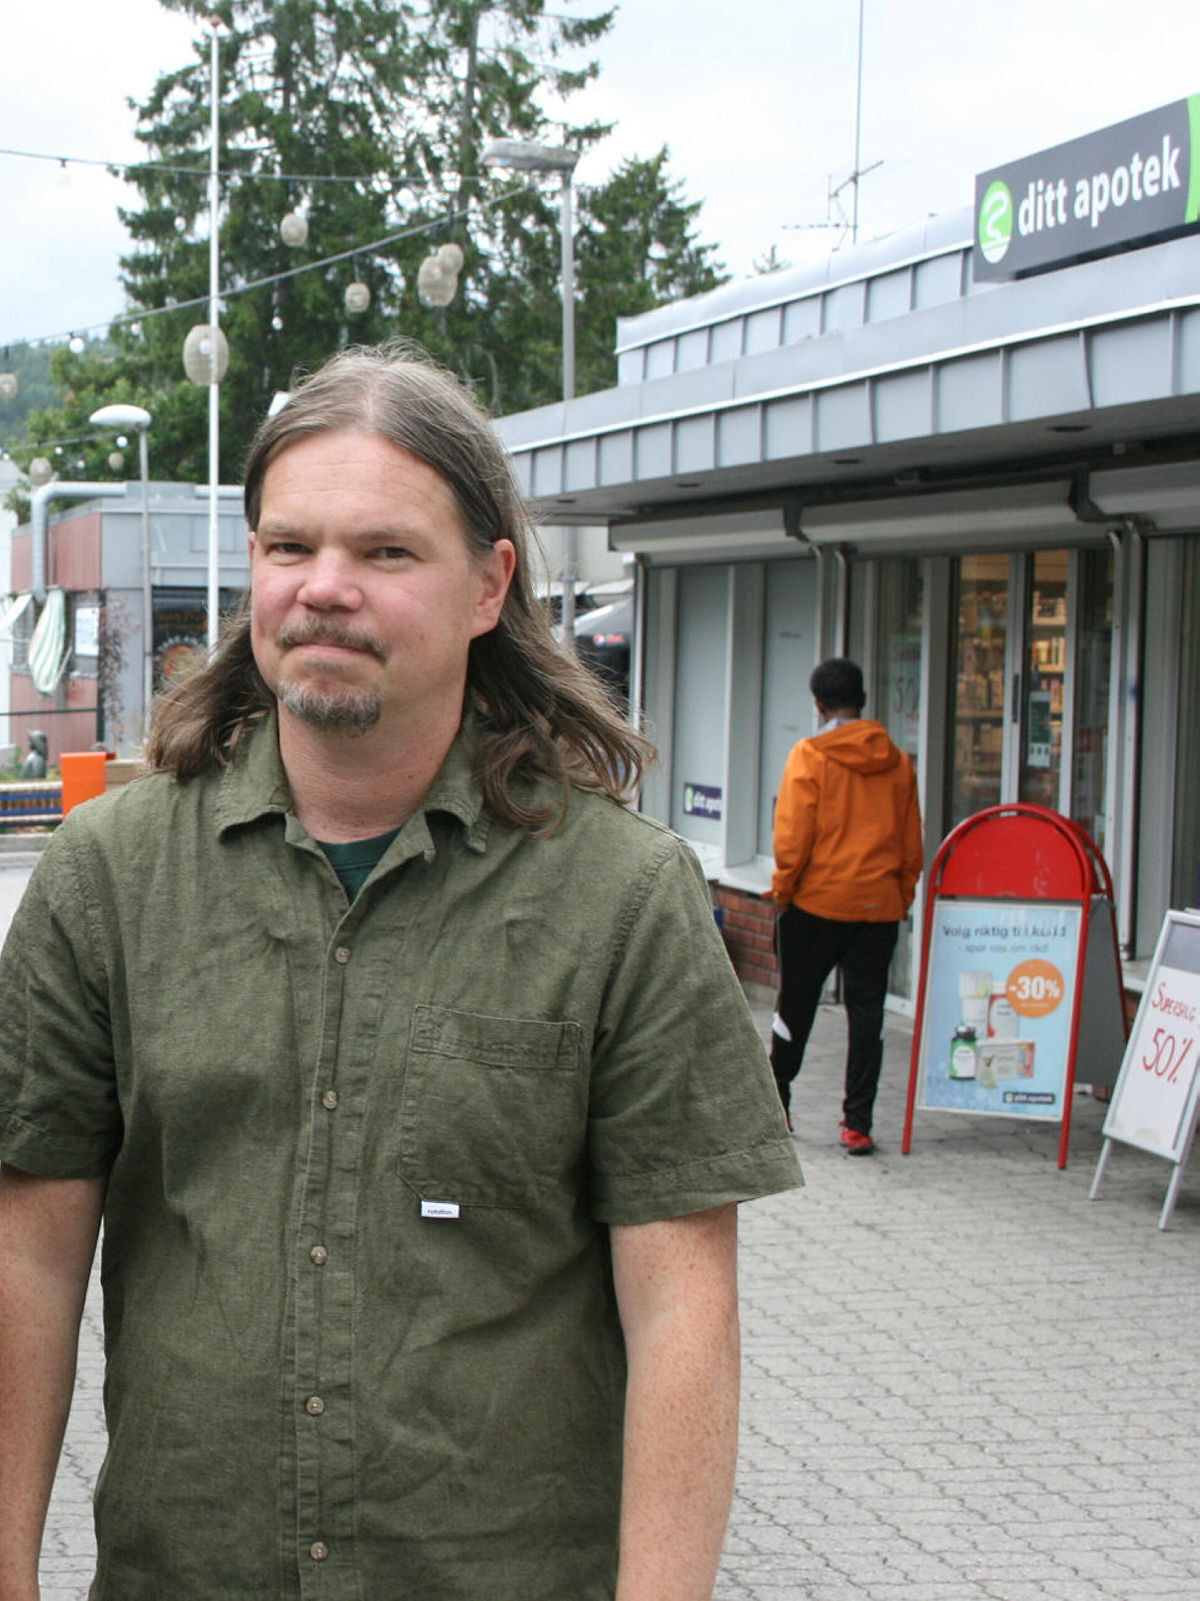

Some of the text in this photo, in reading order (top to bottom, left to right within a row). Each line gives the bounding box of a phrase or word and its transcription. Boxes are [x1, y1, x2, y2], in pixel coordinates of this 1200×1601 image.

[1018, 134, 1181, 236] ditt apotek
[1009, 976, 1060, 1000] -30%
[1142, 1028, 1194, 1084] 50%
